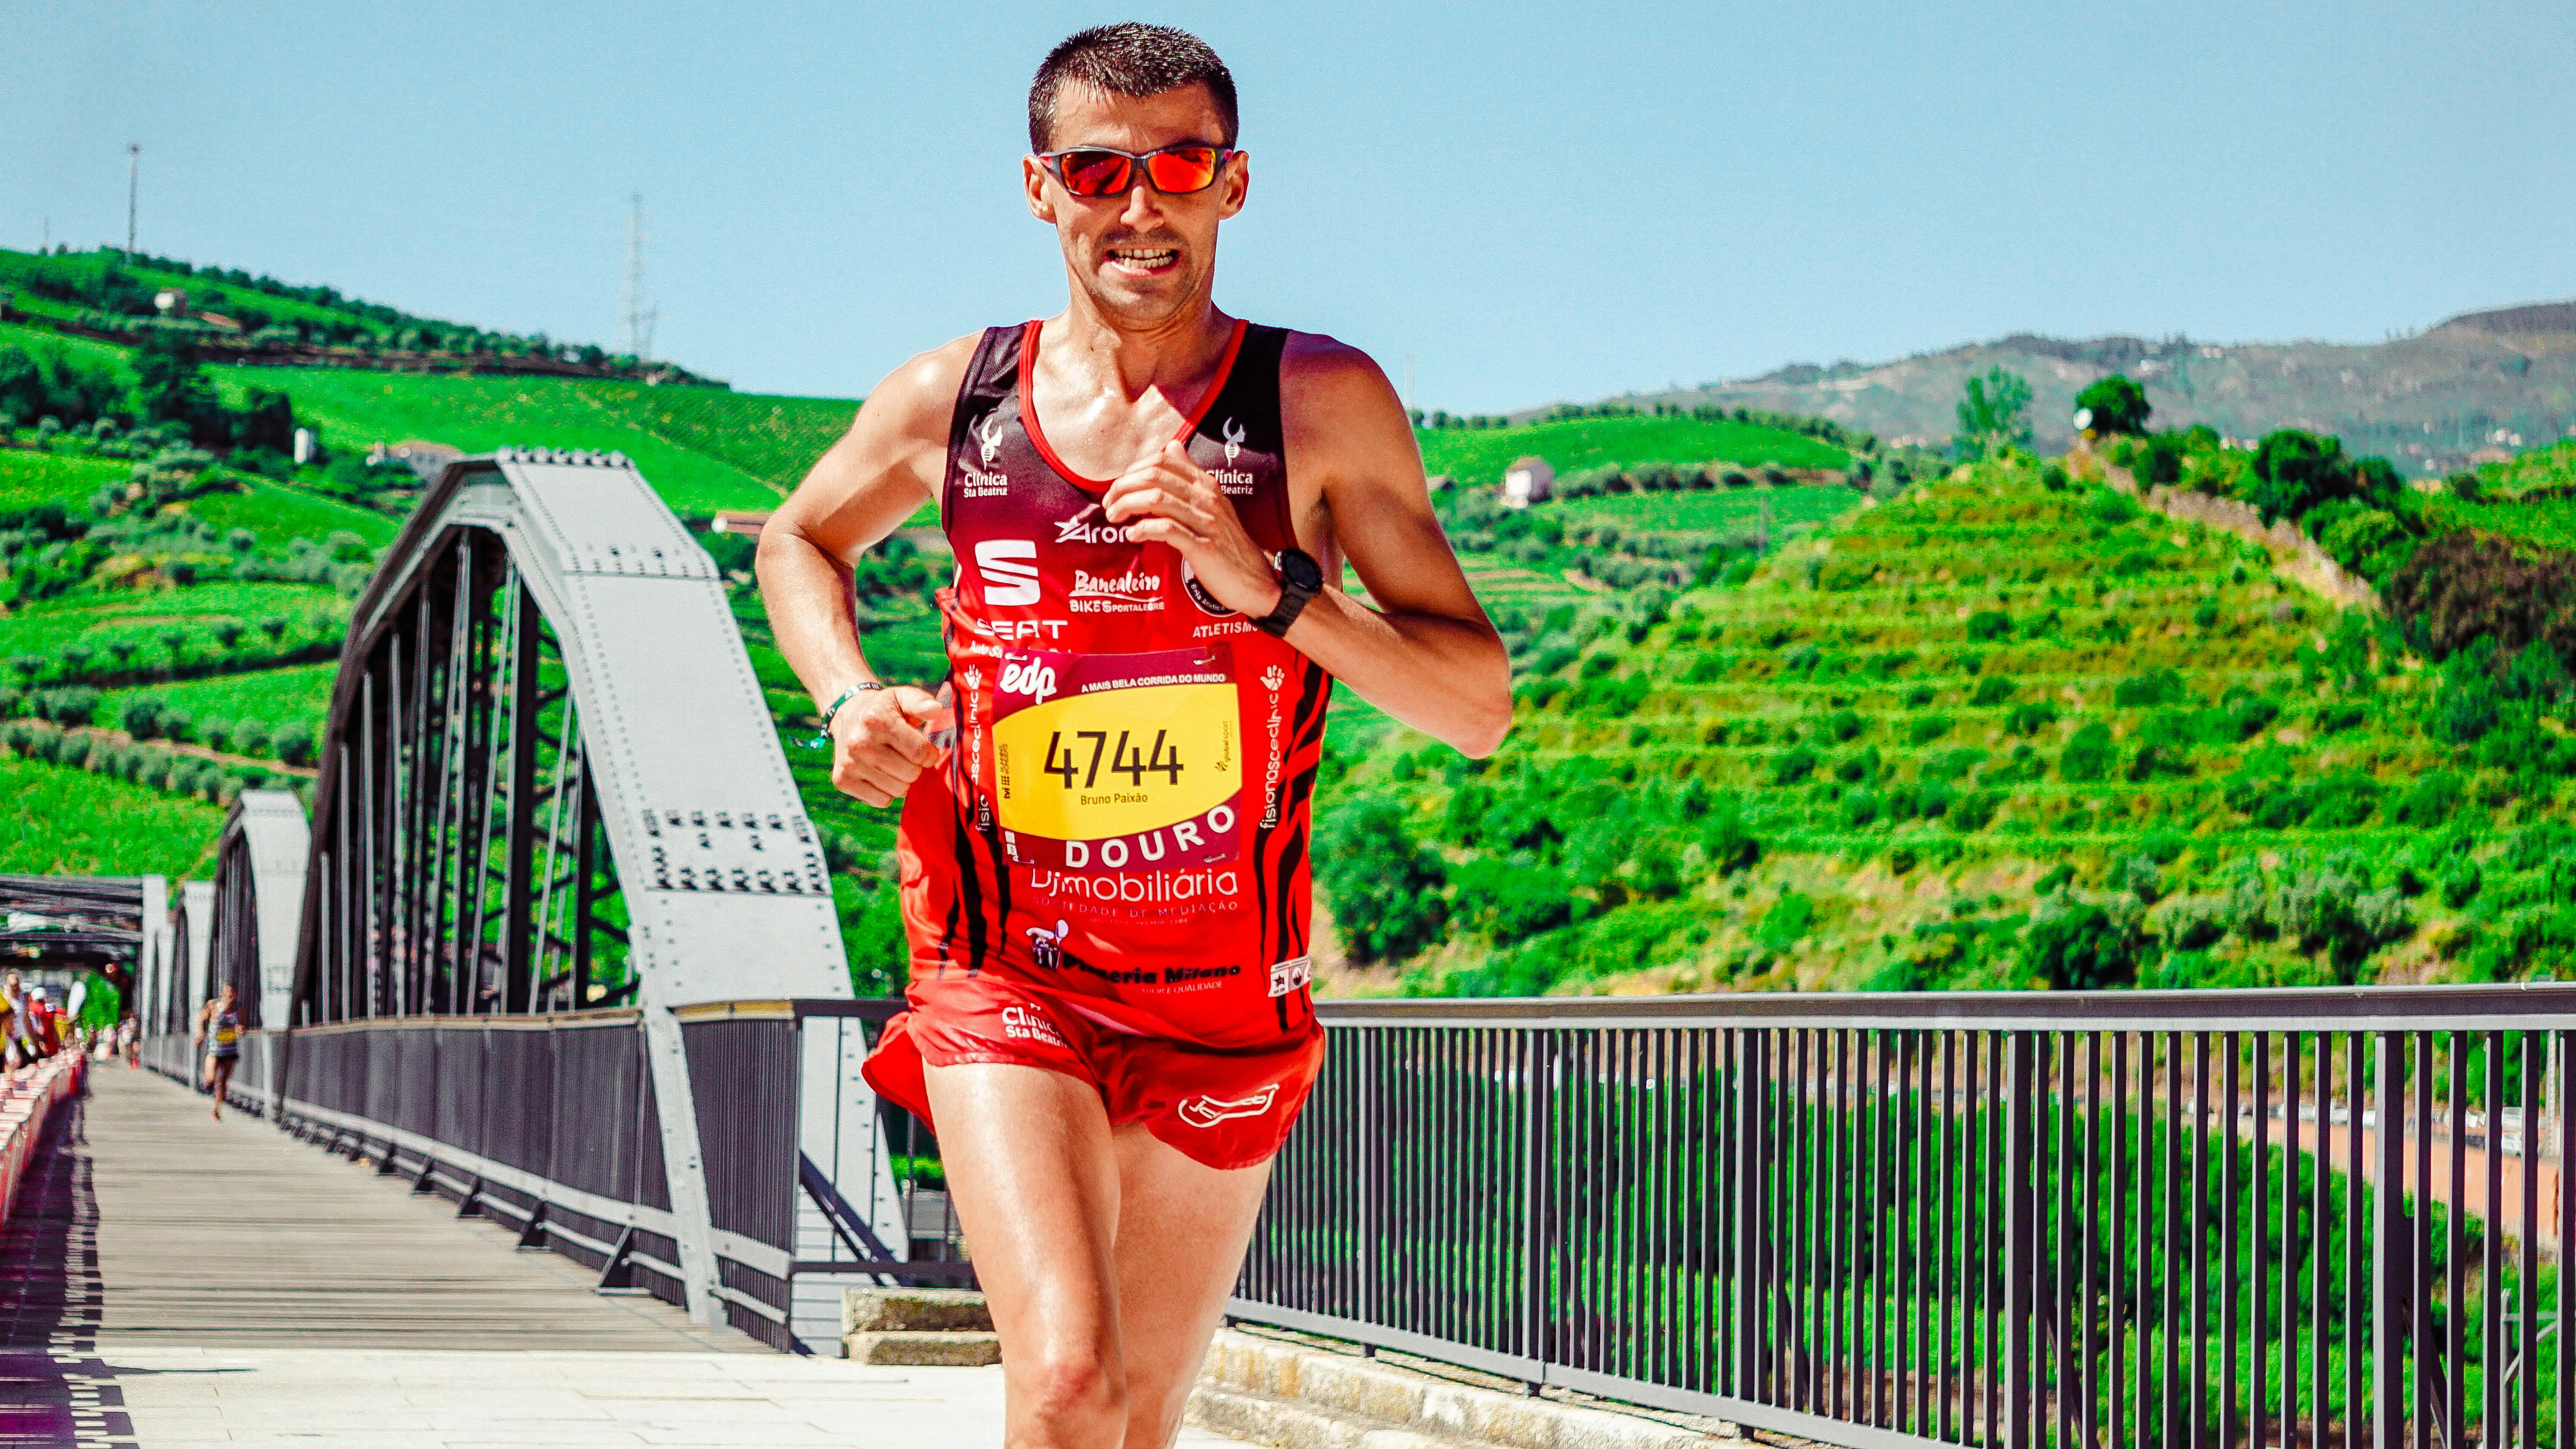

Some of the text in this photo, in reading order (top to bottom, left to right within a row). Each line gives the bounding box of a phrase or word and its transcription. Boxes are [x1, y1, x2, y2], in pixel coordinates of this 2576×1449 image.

[964, 471, 1008, 487] Clínica
[964, 486, 1008, 497] Sta Beatriz
[974, 618, 1069, 640] SEAT
[999, 656, 1057, 705] edp
[1081, 673, 1226, 693] A MAIS BELA CORRIDA DO MUNDO
[1044, 729, 1184, 789] 4744
[1081, 793, 1148, 805] Bruno Paixão
[1066, 805, 1236, 868] DOURO
[1005, 1025, 1031, 1038] Sta
